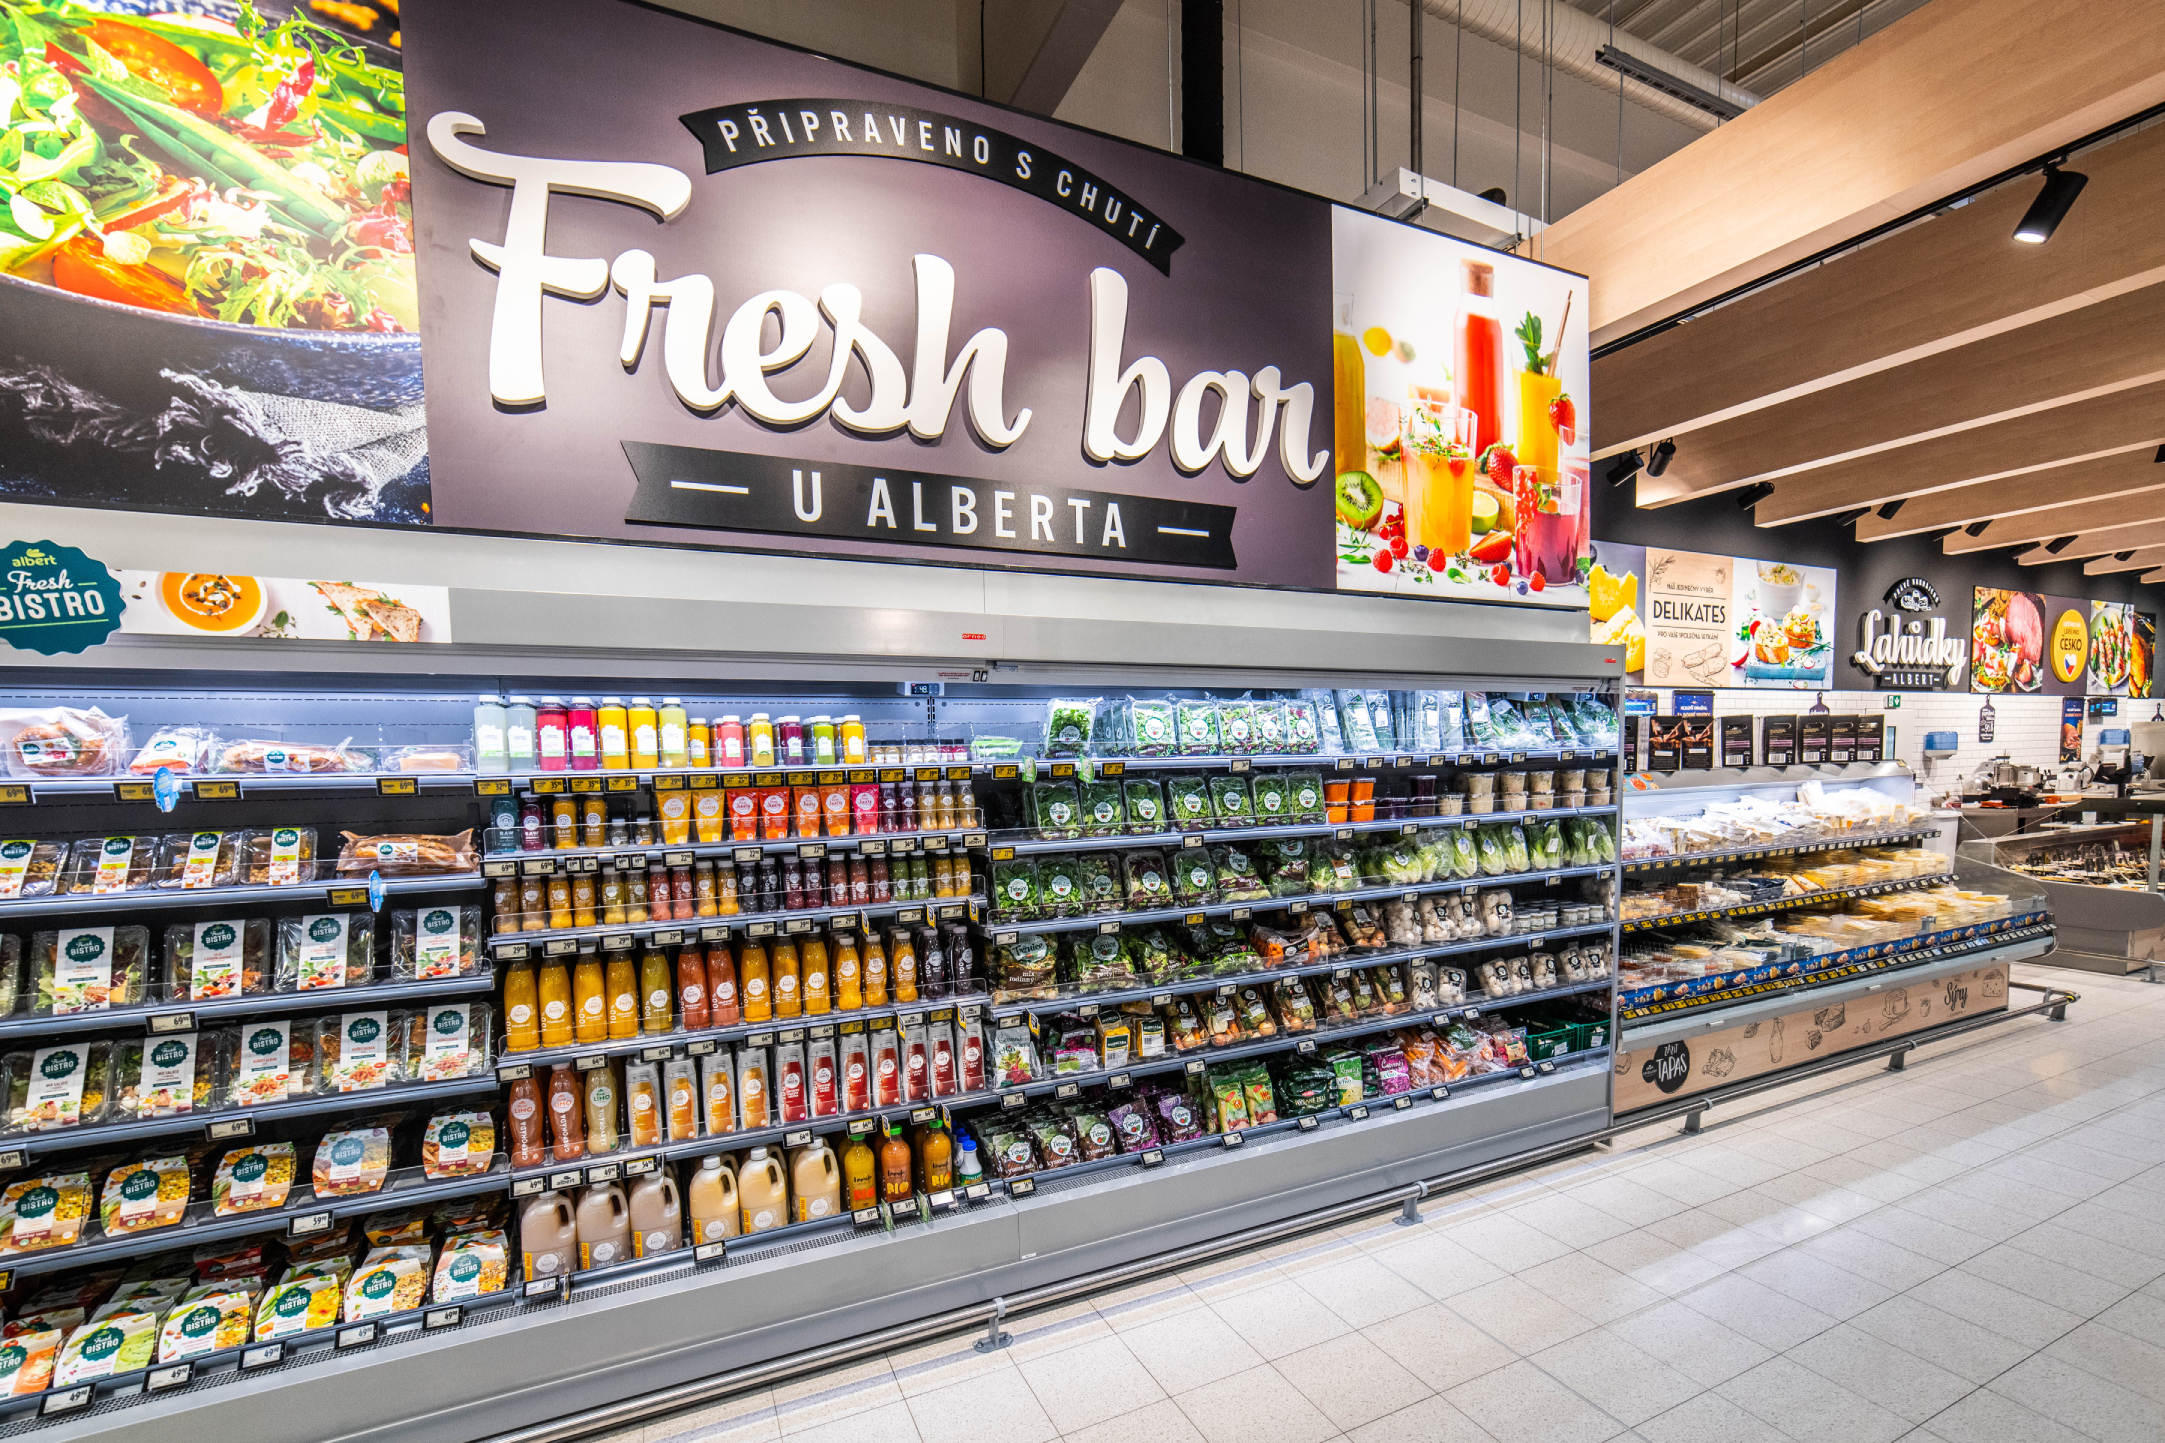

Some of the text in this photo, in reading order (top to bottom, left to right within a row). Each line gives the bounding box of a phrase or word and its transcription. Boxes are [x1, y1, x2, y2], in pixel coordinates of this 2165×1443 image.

[717, 108, 1160, 250] PŘIPRAVENO S CHUTÍ
[427, 111, 1330, 484] Fresh bar
[792, 470, 1127, 549] U ALBERTA
[12, 555, 56, 567] albert
[7, 569, 73, 593] Fresh
[1653, 600, 1726, 623] DELIKATES
[1855, 609, 1967, 685] Lahůdky
[2060, 634, 2082, 651] ČESKO
[1892, 674, 1933, 684] ALBERT
[427, 919, 450, 928] BISTRO
[313, 927, 337, 936] BISTRO
[206, 933, 232, 944] BISTRO
[70, 944, 100, 956] BISTRO
[1009, 976, 1034, 984] rodinný
[1944, 982, 1968, 1011] Sýry
[438, 1018, 460, 1029] BISTRO
[352, 1026, 377, 1038] BISTRO
[253, 1038, 279, 1049] BISTRO
[156, 1051, 184, 1062] BISTRO
[45, 1061, 74, 1073] BISTRO
[1656, 1053, 1687, 1082] TAPAS
[443, 1130, 467, 1142] BISTRO
[335, 1147, 361, 1159] BISTRO
[236, 1164, 264, 1176] BISTRO
[556, 1177, 576, 1186] albert
[932, 1172, 951, 1186] BIO
[126, 1180, 156, 1194] BISTRO
[887, 1182, 909, 1194] BIO
[854, 1187, 875, 1201] BIO
[21, 1197, 54, 1211] BISTRO
[453, 1264, 478, 1277] BISTRO
[366, 1279, 393, 1294] BISTRO
[279, 1297, 307, 1312] BISTRO
[185, 1315, 216, 1333] BISTRO
[86, 1337, 119, 1355] BISTRO
